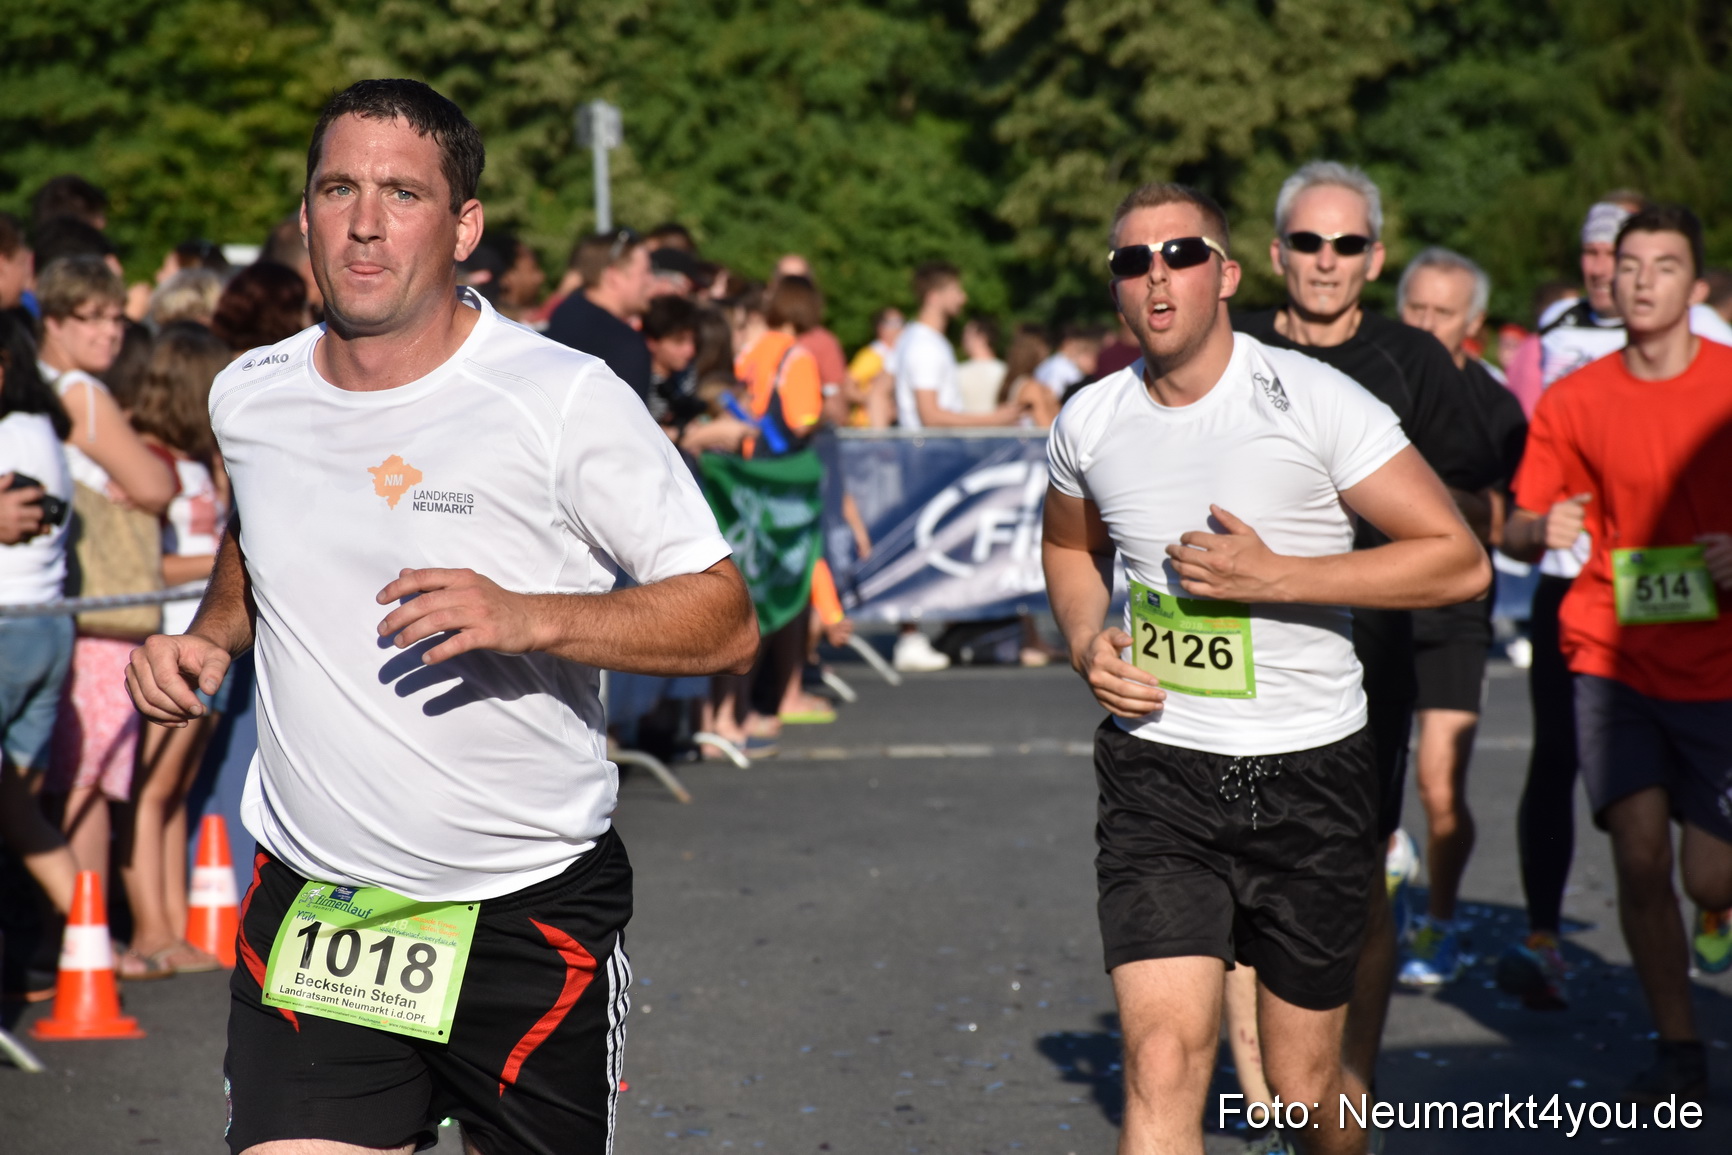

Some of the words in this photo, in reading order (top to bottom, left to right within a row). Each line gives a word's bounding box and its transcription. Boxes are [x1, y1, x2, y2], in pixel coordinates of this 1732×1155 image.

[257, 353, 290, 367] JAKO
[384, 474, 404, 487] NM
[412, 501, 475, 515] NEUMARKT
[413, 490, 474, 504] LANDKREIS
[1636, 573, 1691, 602] 514
[1141, 622, 1234, 670] 2126
[315, 894, 374, 919] firmenlauf
[297, 921, 438, 995] 1018
[279, 984, 340, 1007] Landratsamt
[341, 997, 389, 1017] Neumarkt
[390, 1008, 427, 1024] i.d.OPf.
[294, 972, 367, 999] Beckstein
[370, 988, 417, 1010] Stefan
